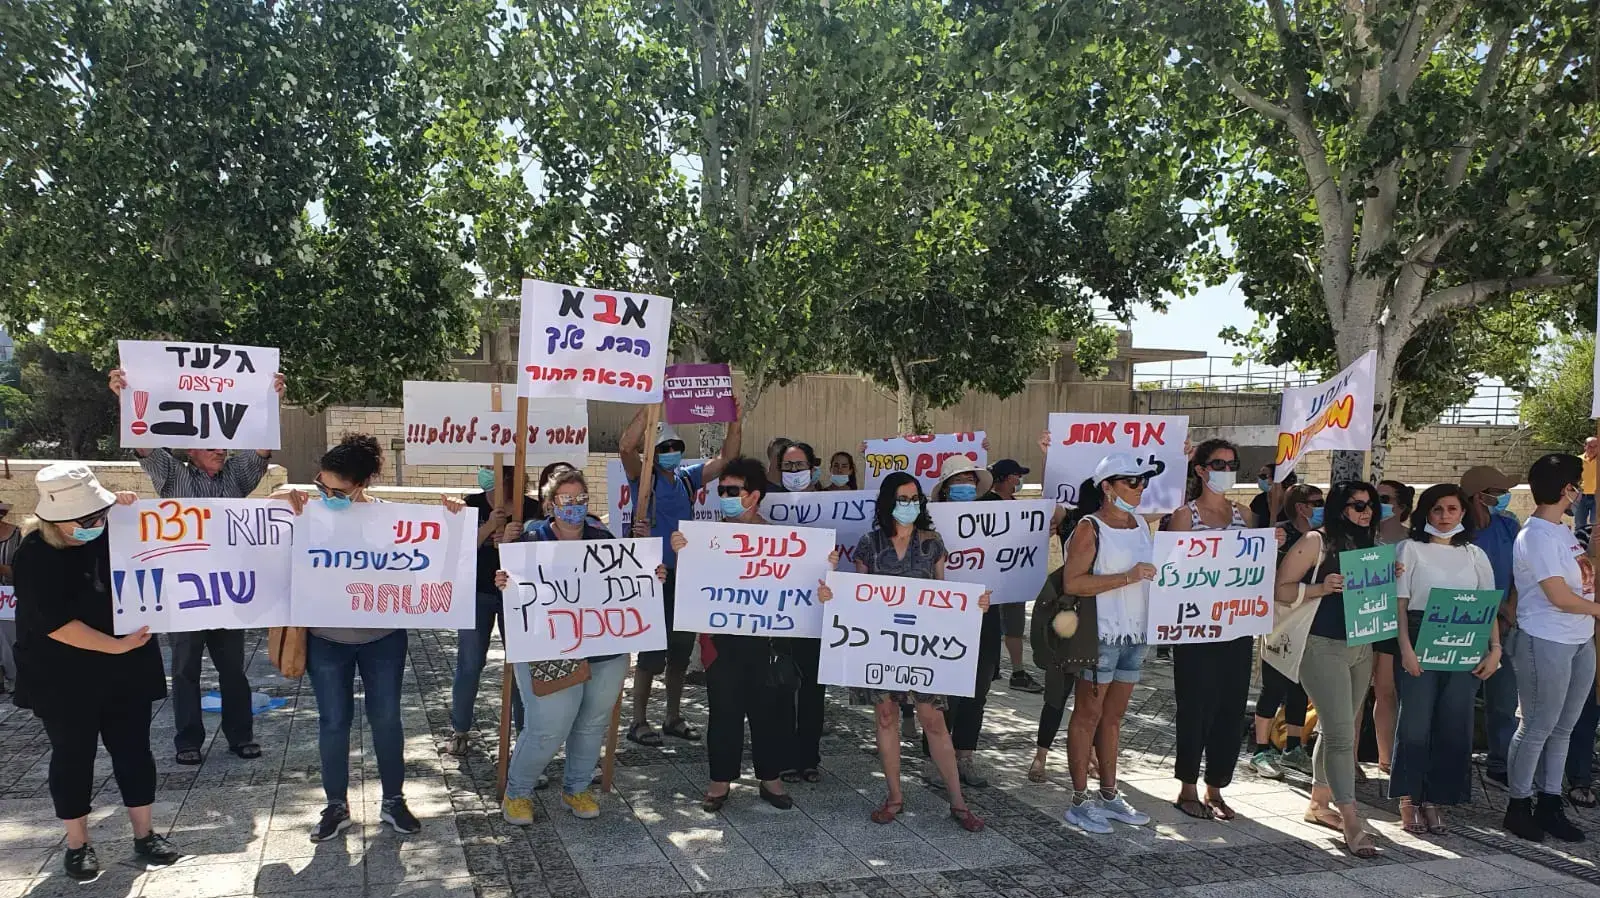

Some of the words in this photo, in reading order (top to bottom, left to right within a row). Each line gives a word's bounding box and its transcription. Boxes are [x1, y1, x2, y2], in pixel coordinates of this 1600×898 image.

[558, 289, 649, 328] אבא
[545, 324, 585, 355] שלך
[596, 335, 651, 358] הבת
[166, 345, 255, 373] גלעד
[178, 375, 233, 392] ירצח
[582, 367, 653, 393] הבאה
[668, 377, 693, 388] נשים
[695, 376, 720, 387] לרצח
[131, 390, 248, 440] שוב!
[546, 425, 587, 445] מאסר
[1063, 421, 1117, 446] אחת
[1124, 422, 1166, 448] אף
[139, 500, 212, 542] ירצח
[769, 503, 822, 524] נשים
[957, 511, 1010, 539] נשים
[1021, 510, 1045, 532] חיי
[225, 507, 294, 546] הוא
[725, 531, 807, 557] לעינב
[1178, 537, 1222, 558] דמי
[1236, 531, 1265, 562] קול
[308, 548, 430, 571] למשפחה
[739, 559, 791, 580] שלנו
[996, 545, 1039, 573] אינם
[1182, 567, 1221, 589] שלנו
[1225, 566, 1265, 587] עינב
[1346, 561, 1394, 595] النهاية
[346, 581, 453, 614] מנוחה
[602, 575, 655, 605] הבת
[700, 586, 769, 606] שחרור
[778, 588, 812, 612] אין
[855, 583, 906, 607] נשים
[918, 588, 968, 611] רצח
[1177, 603, 1200, 624] מן
[1358, 592, 1388, 615] للعنف
[709, 612, 795, 634] מוקדם
[1348, 615, 1379, 638] النساء
[1382, 613, 1398, 632] ضد
[1428, 605, 1497, 628] النهاية
[547, 607, 651, 654] בסכנה
[830, 615, 870, 648] כל
[1157, 624, 1222, 641] האדמה
[1433, 631, 1476, 647] للعنف
[880, 629, 967, 660] מאסר
[1417, 648, 1458, 665] النساء
[1459, 651, 1481, 665] ضد
[866, 663, 934, 687] החיים
